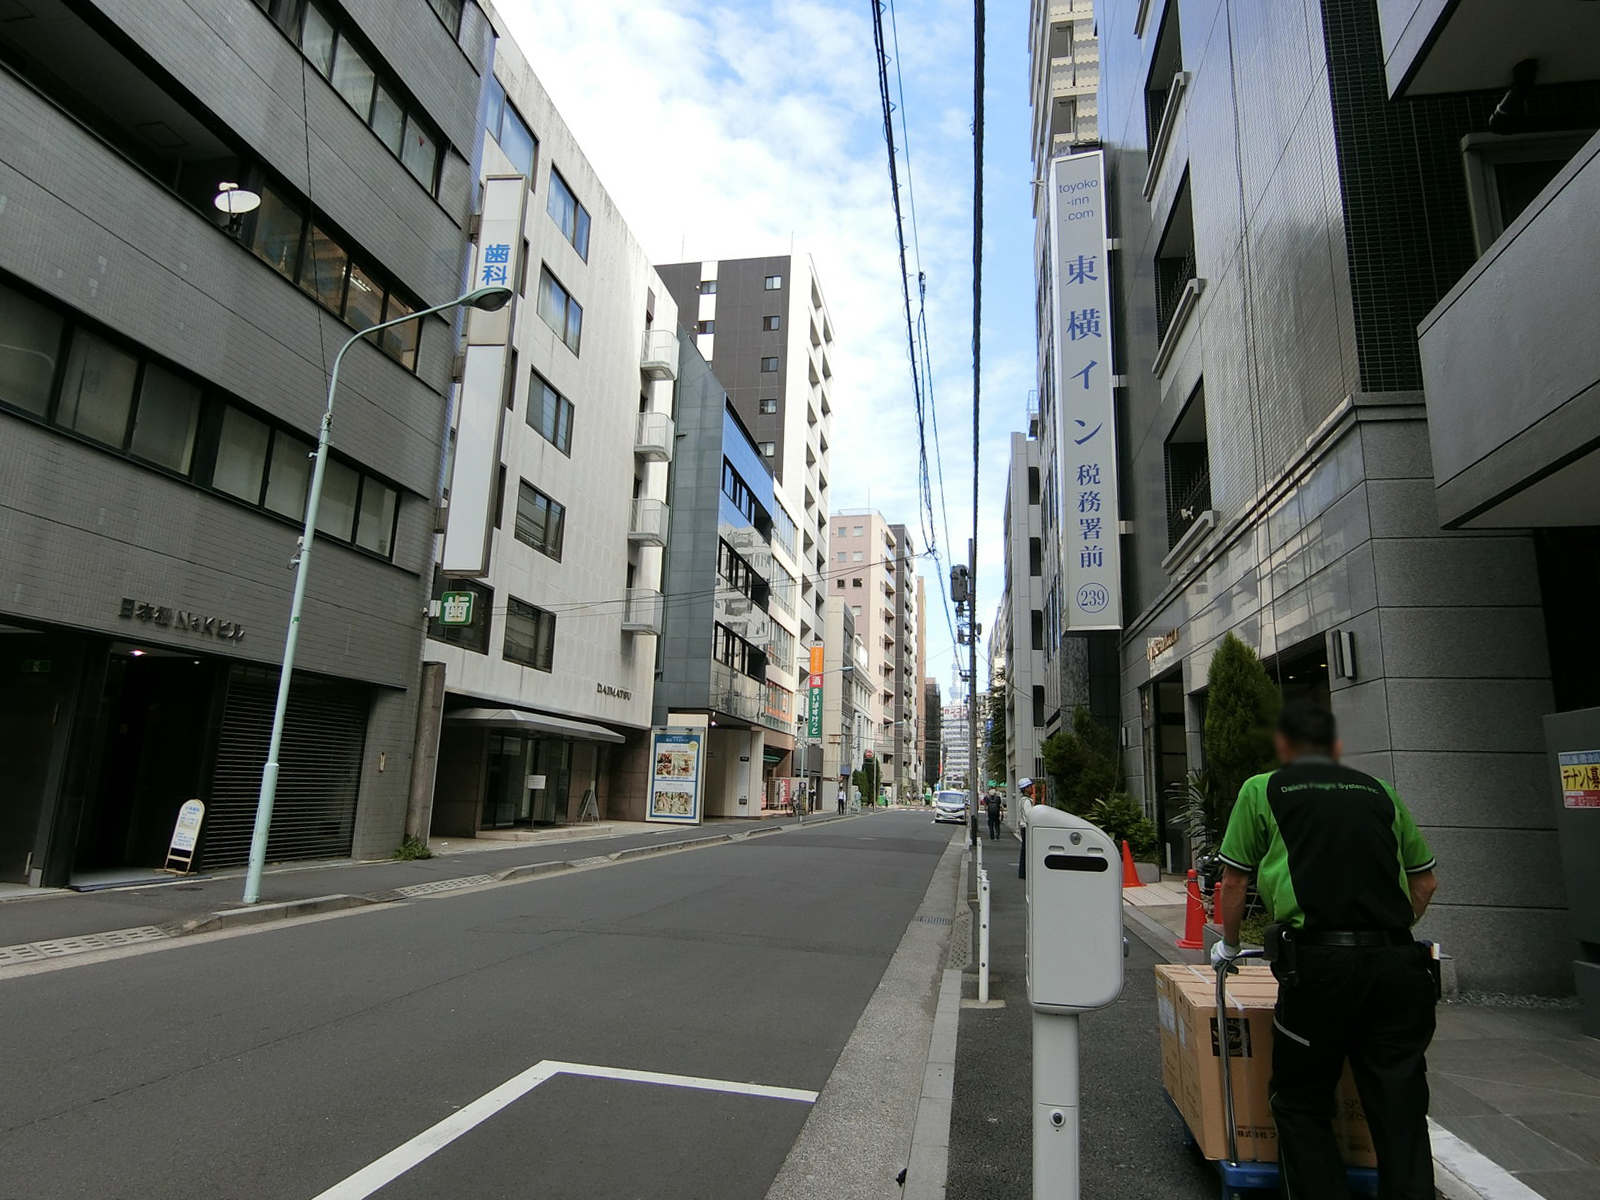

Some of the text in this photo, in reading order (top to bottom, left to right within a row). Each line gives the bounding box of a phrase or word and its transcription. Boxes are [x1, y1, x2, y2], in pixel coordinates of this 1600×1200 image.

[1059, 179, 1098, 193] toyoko
[1067, 196, 1089, 206] -inn
[1064, 209, 1094, 222] .com
[481, 243, 511, 286] 歯科
[1065, 254, 1103, 569] 東横イン 税務署前
[1080, 589, 1105, 607] 239
[443, 594, 470, 622] 歯
[811, 675, 821, 686] 酒
[596, 682, 632, 701] DAIMATSU
[1280, 783, 1308, 793] Daiichi
[1337, 782, 1367, 791] System
